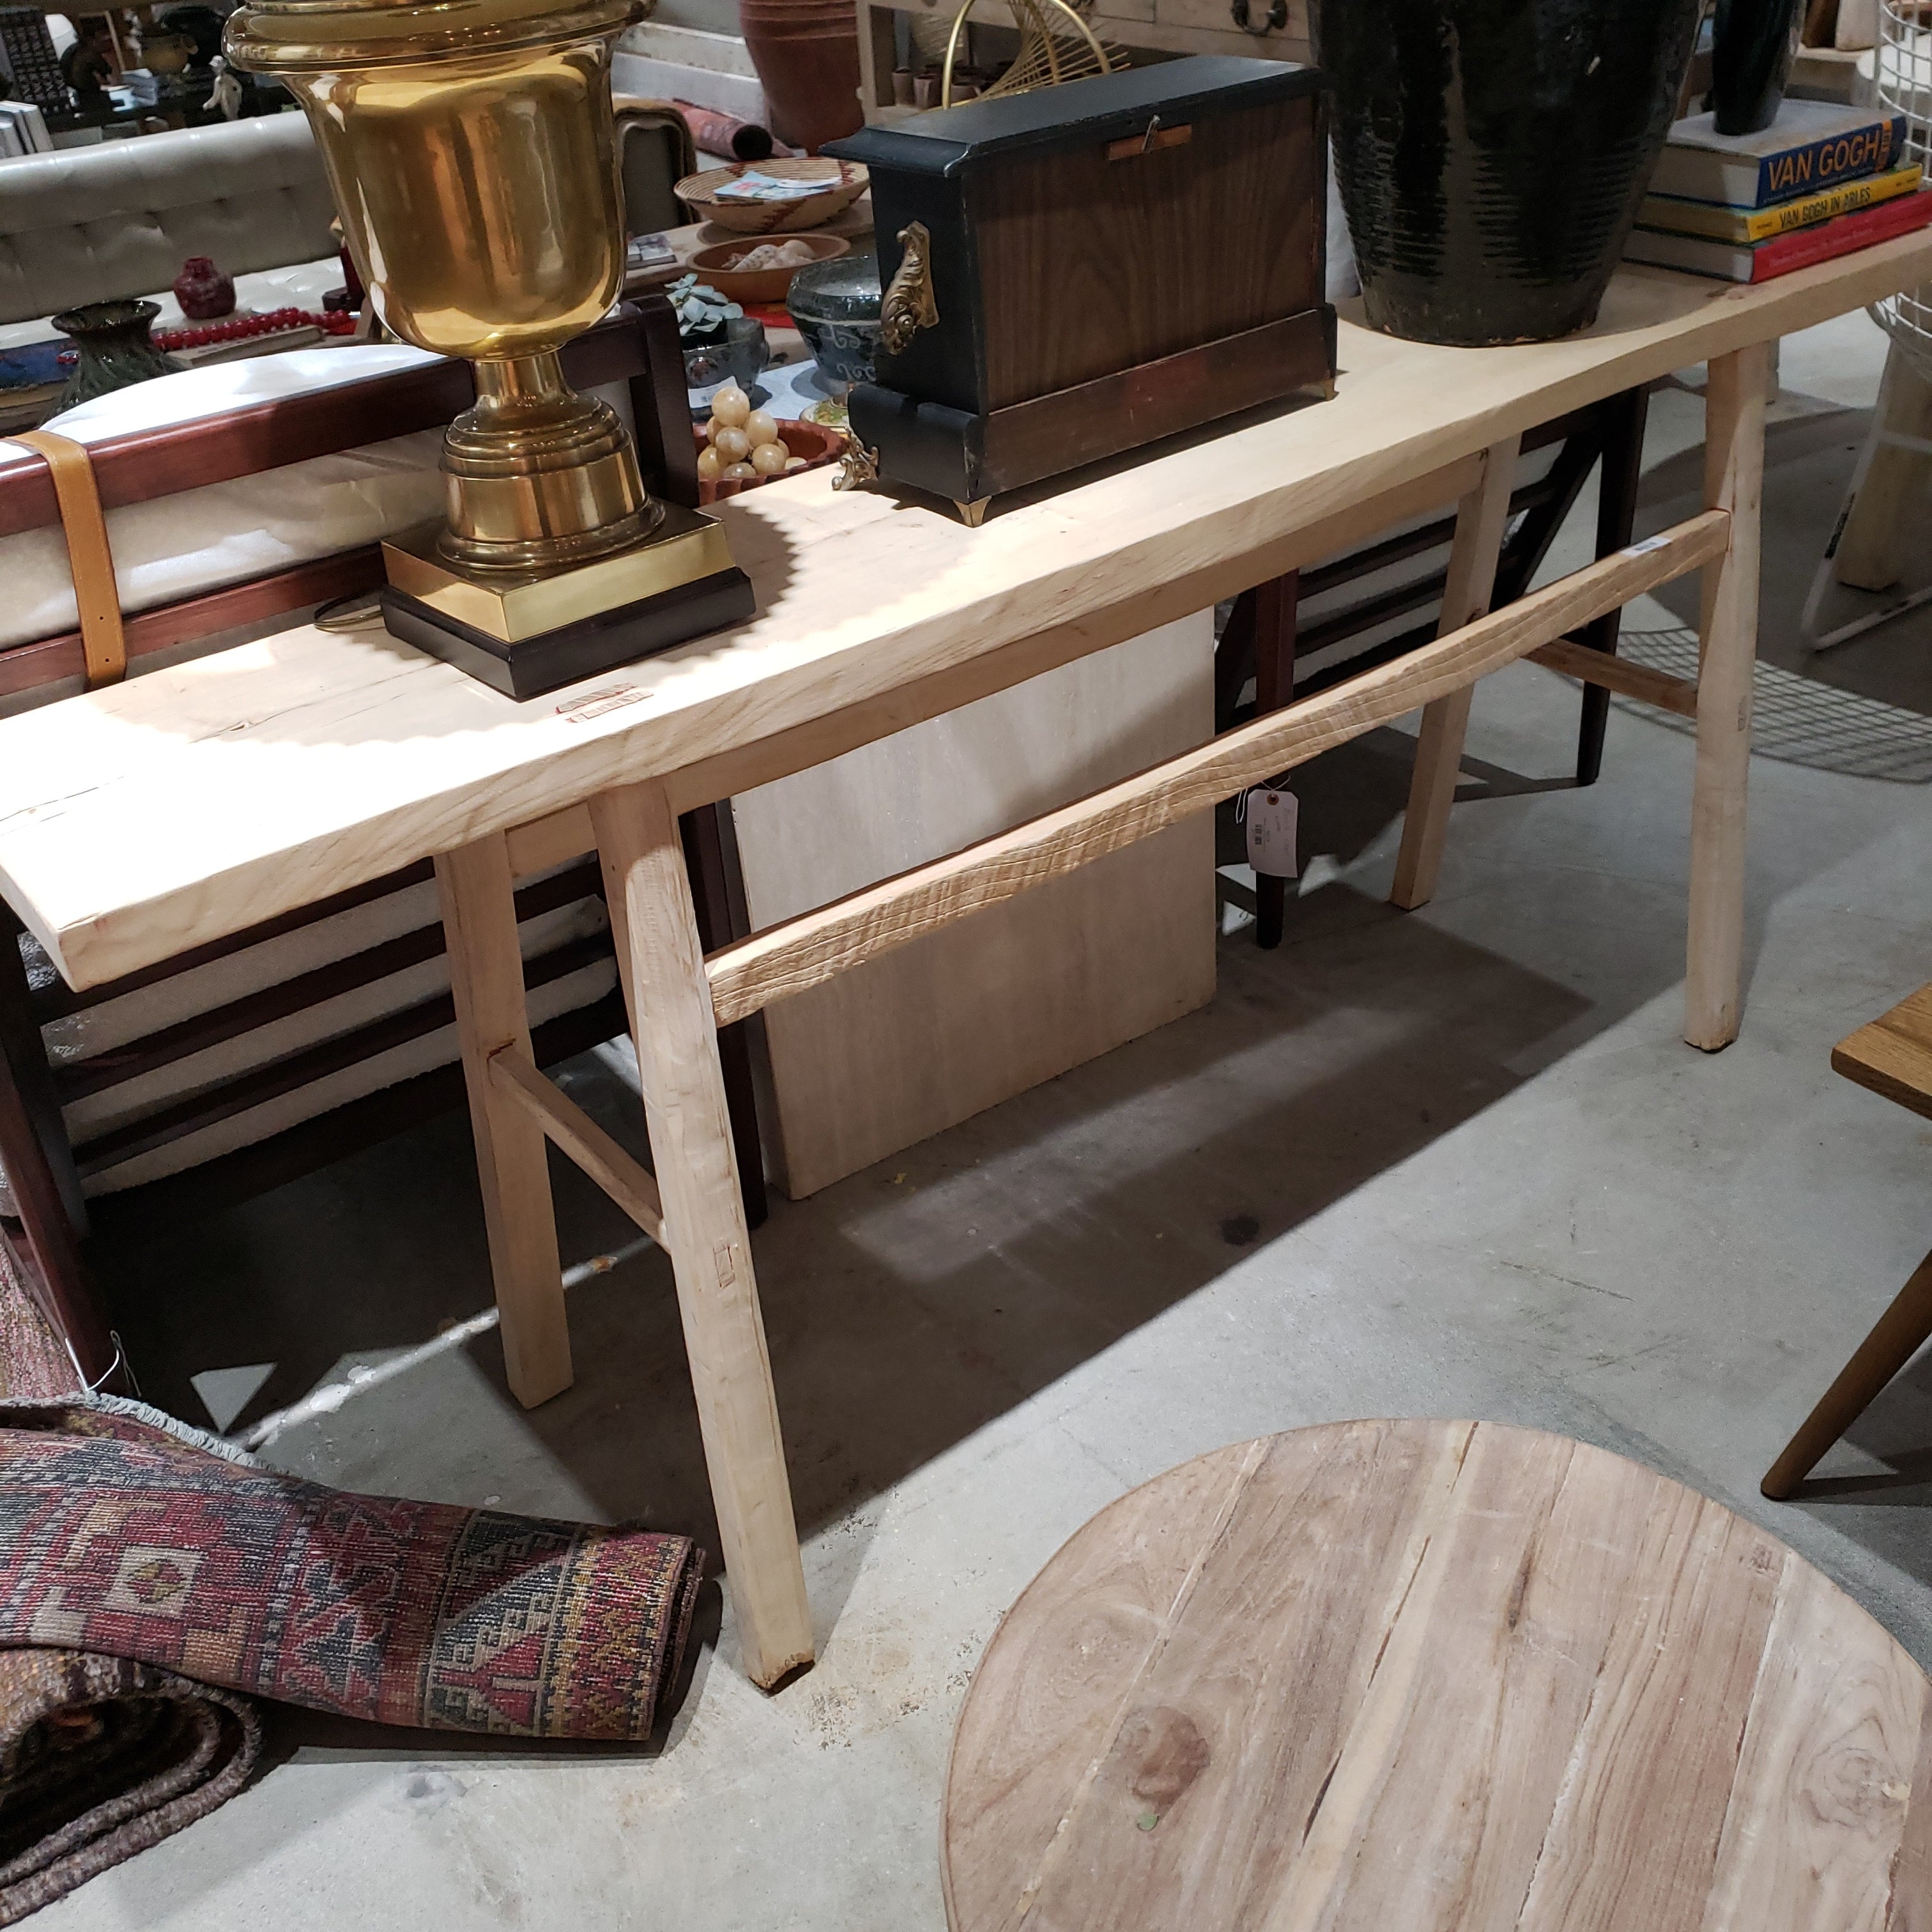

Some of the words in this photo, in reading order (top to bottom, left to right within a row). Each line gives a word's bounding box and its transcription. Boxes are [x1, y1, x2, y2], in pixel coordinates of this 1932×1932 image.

[1768, 150, 1813, 191] VAN
[1818, 129, 1881, 176] GOGH
[1779, 208, 1799, 229] VAN
[1802, 199, 1828, 222] GOGH
[1830, 195, 1841, 212] IN
[1844, 187, 1871, 209] ARLES
